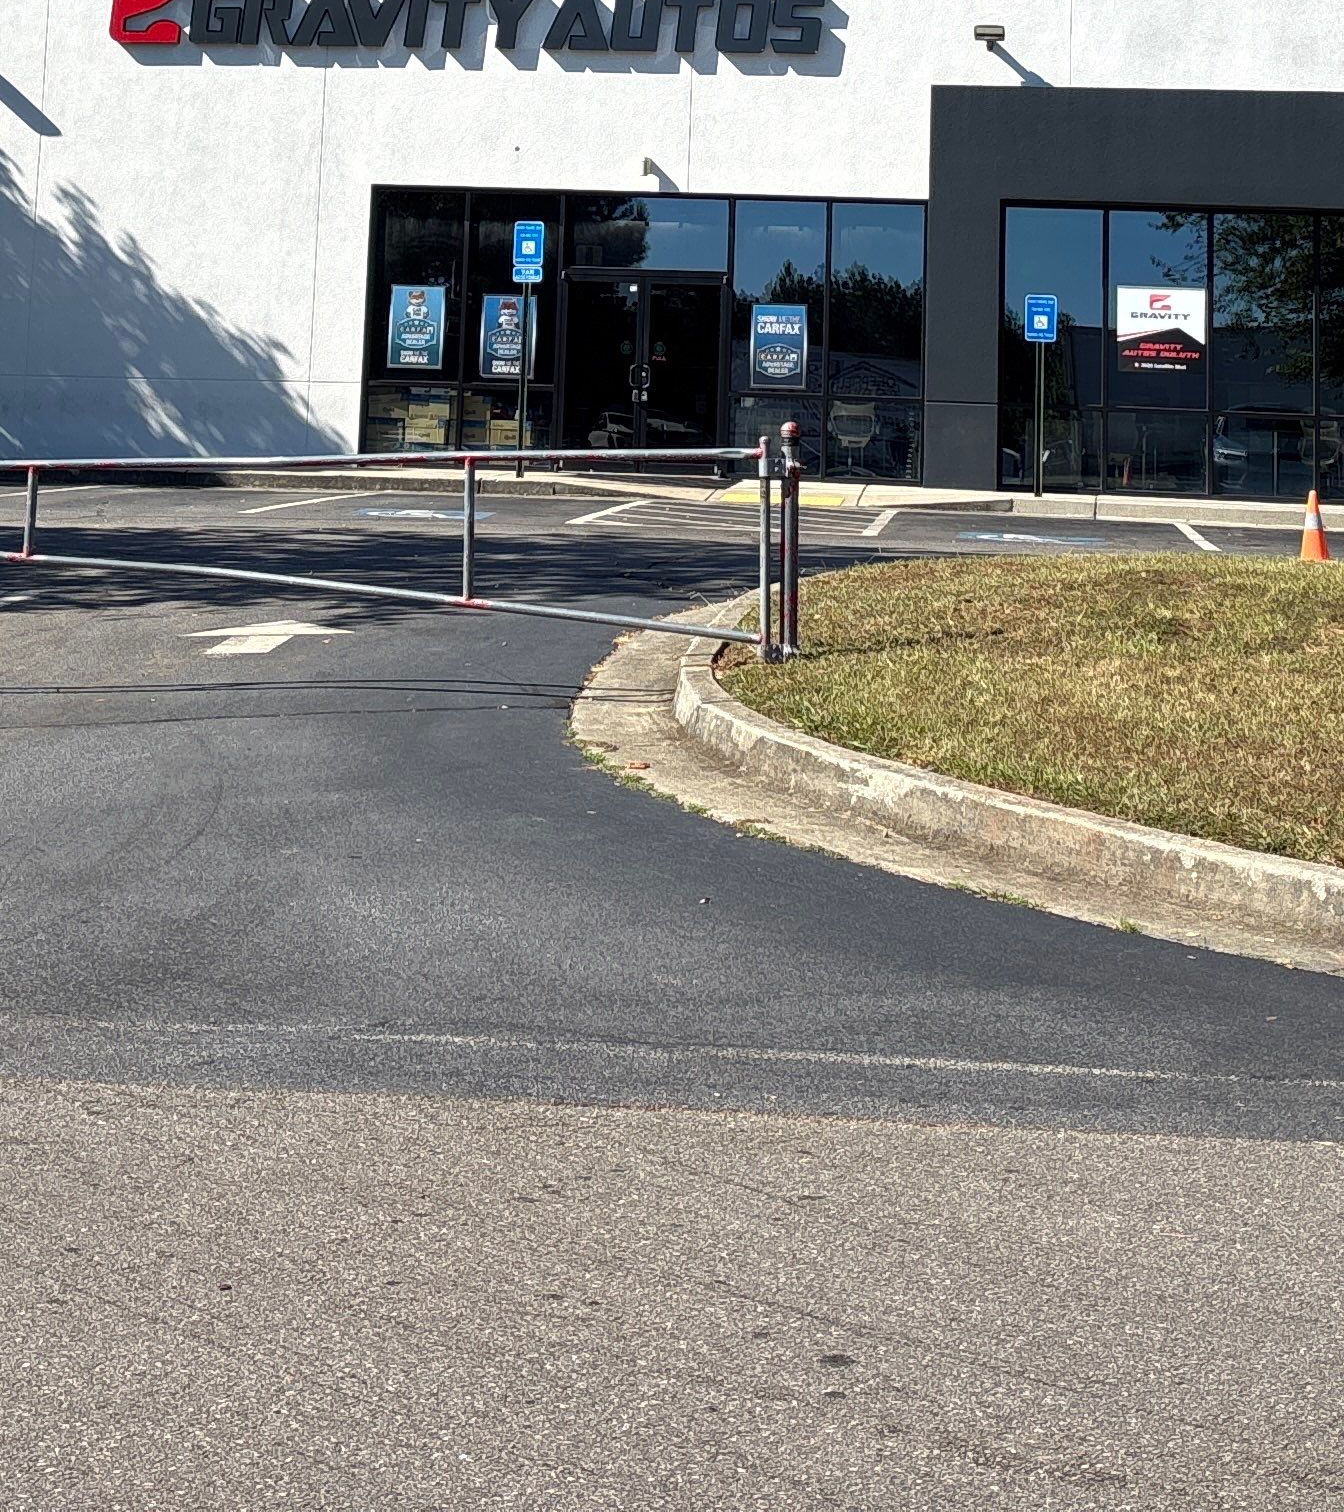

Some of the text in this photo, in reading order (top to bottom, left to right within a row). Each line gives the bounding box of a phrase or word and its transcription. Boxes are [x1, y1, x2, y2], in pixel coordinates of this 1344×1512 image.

[1130, 311, 1190, 320] GRAVITY
[757, 323, 801, 335] CARFAX
[1139, 342, 1183, 351] GRAVITY
[491, 365, 521, 374] CARFAX
